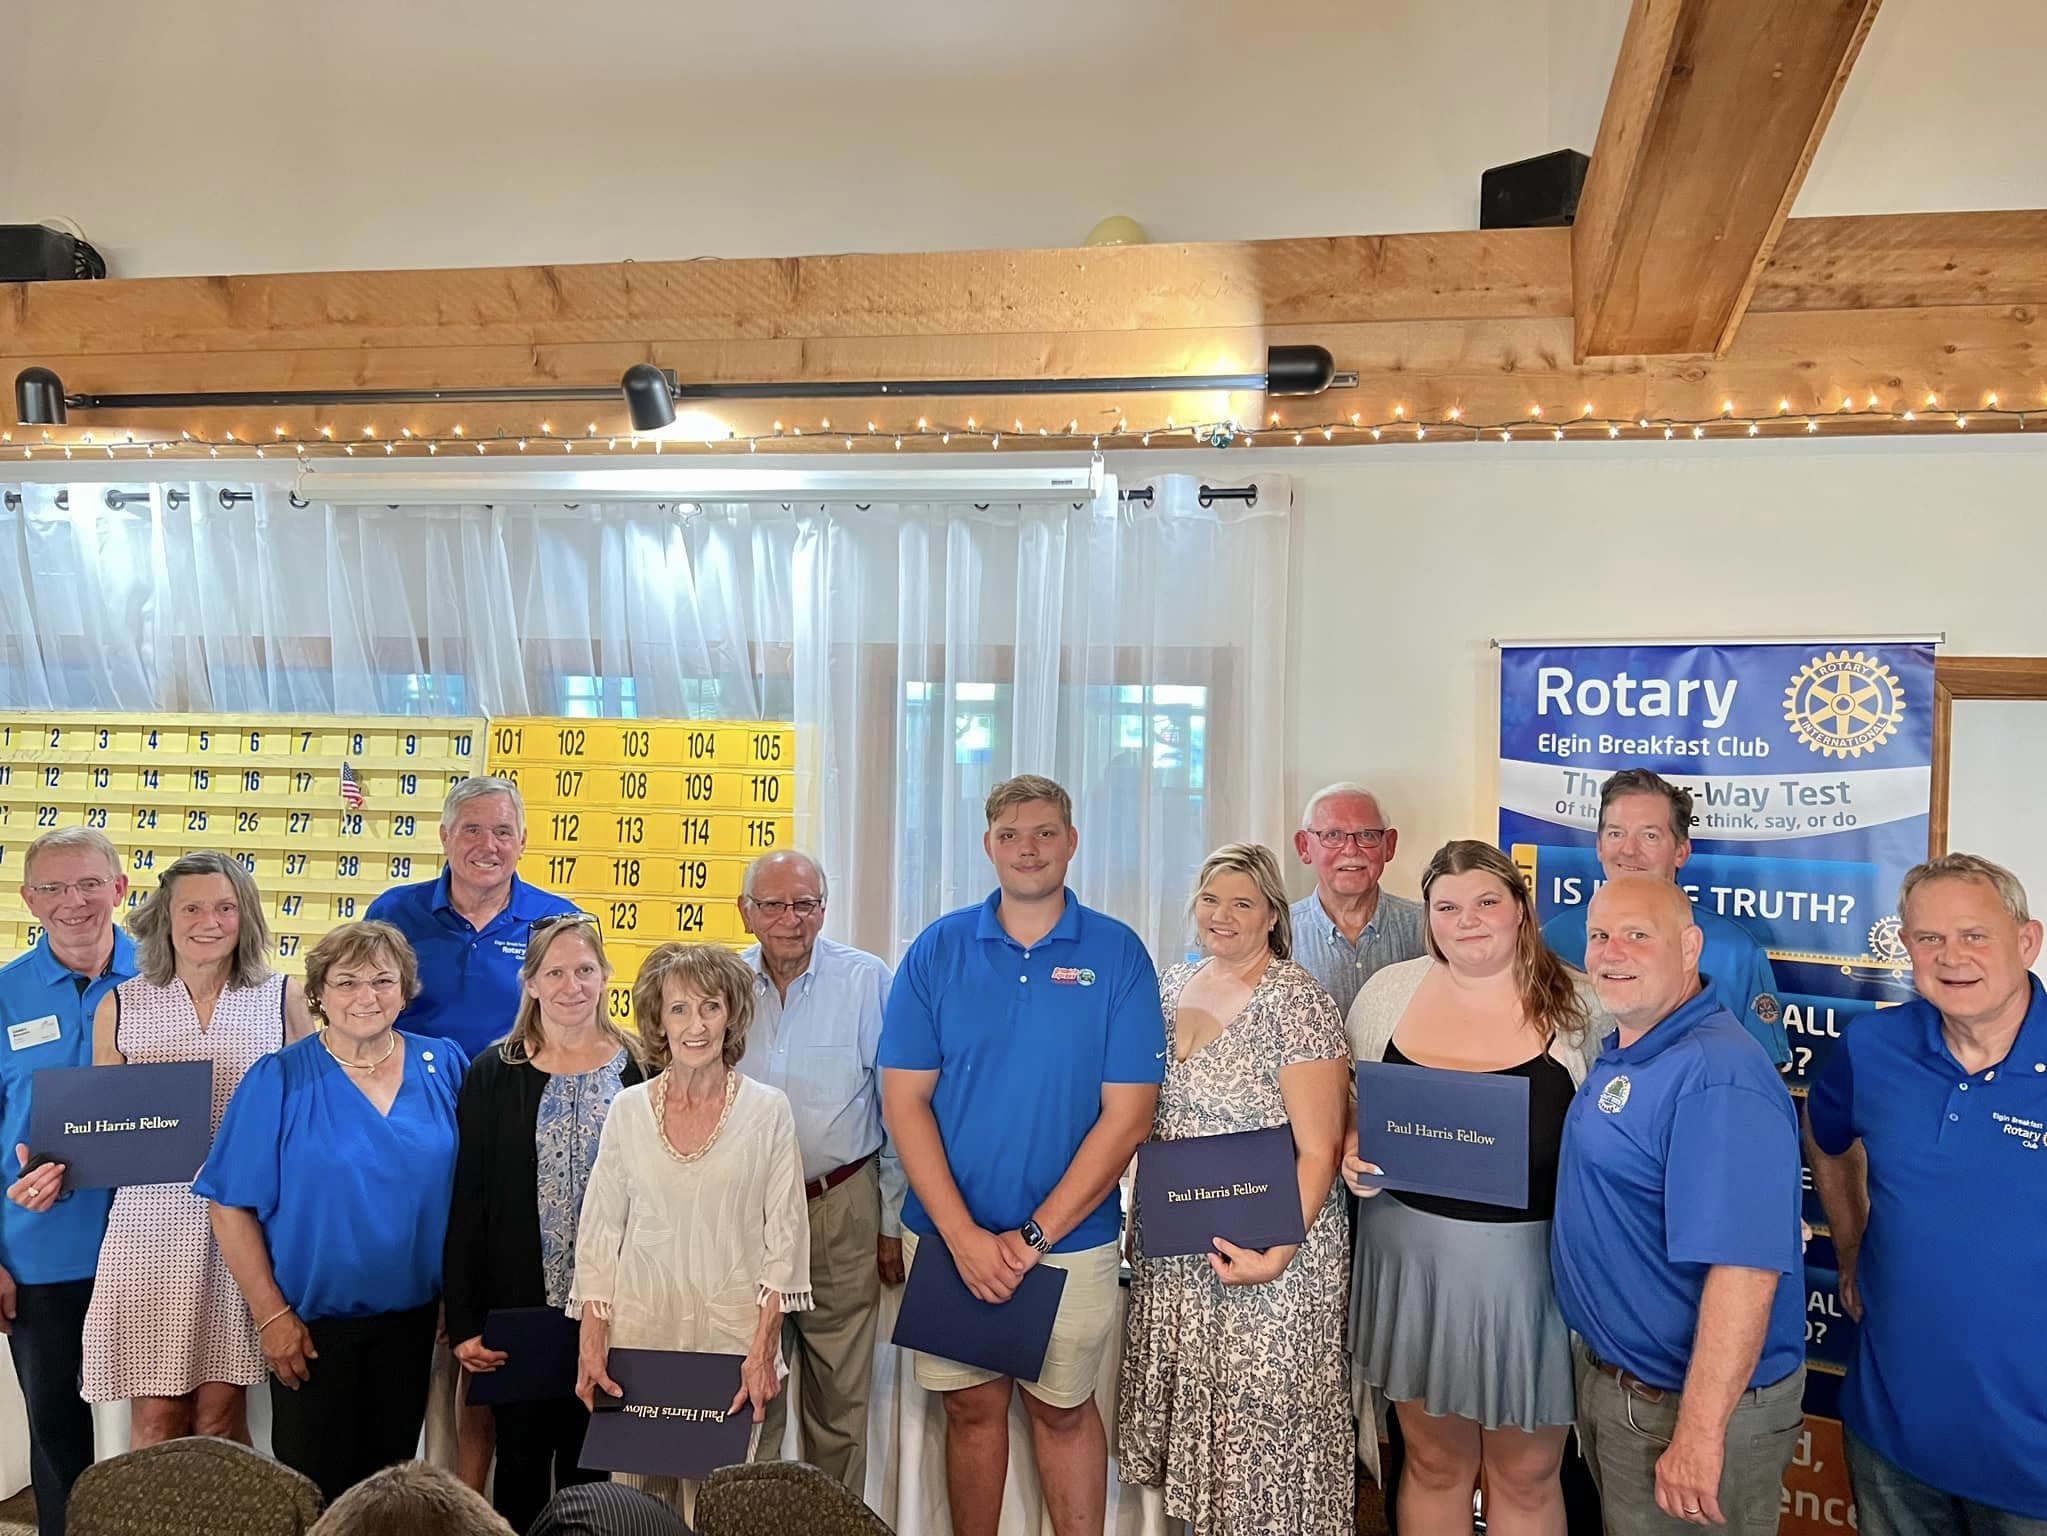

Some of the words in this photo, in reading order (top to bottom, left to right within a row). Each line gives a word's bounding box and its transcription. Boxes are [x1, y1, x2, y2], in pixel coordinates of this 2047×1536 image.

[1819, 661, 1870, 676] ROTARY
[1537, 667, 1738, 728] Rotary
[4, 727, 10, 746] 1
[50, 728, 60, 748] 2
[99, 729, 108, 749] 3
[148, 730, 157, 749] 4
[200, 731, 209, 751] 5
[250, 732, 259, 752] 6
[301, 731, 312, 752] 7
[353, 733, 363, 755] 8
[406, 734, 416, 755] 9
[454, 735, 472, 756] 10
[495, 728, 522, 754] 101
[558, 729, 585, 756] 102
[622, 731, 649, 757] 103
[688, 732, 715, 759] 104
[753, 734, 781, 760] 105
[1538, 733, 1592, 757] Elgin
[1599, 735, 1711, 756] Breakfast
[1717, 736, 1770, 757] Club
[1801, 720, 1887, 748] INTERNATIONAL
[45, 767, 60, 787] 12
[94, 768, 109, 788] 13
[143, 769, 158, 789] 14
[194, 769, 209, 789] 15
[244, 771, 260, 791] 16
[296, 772, 312, 792] 17
[400, 774, 417, 795] 19
[556, 771, 583, 797] 107
[620, 772, 647, 799] 108
[685, 774, 713, 801] 109
[752, 776, 779, 802] 110
[1563, 771, 1600, 798] Th
[1779, 781, 1852, 806] Test
[38, 806, 57, 827] 22
[88, 808, 107, 828] 23
[137, 809, 156, 829] 24
[188, 810, 207, 831] 25
[239, 811, 259, 832] 26
[290, 812, 310, 833] 27
[342, 814, 362, 835] 28
[394, 815, 415, 836] 29
[1555, 800, 1575, 815] Of
[1580, 803, 1600, 818] th
[1705, 813, 1759, 830] think,
[1765, 816, 1801, 832] say,
[1807, 815, 1827, 828] or
[1832, 811, 1857, 827] do
[552, 814, 579, 841] 112
[617, 816, 643, 843] 113
[682, 818, 709, 845] 114
[748, 820, 775, 847] 115
[134, 849, 153, 869] 34
[286, 854, 306, 874] 37
[338, 855, 359, 877] 38
[391, 857, 411, 878] 39
[549, 856, 576, 884] 117
[613, 859, 640, 886] 118
[679, 861, 707, 888] 119
[282, 896, 302, 916] 47
[1554, 876, 1582, 905] IS
[1710, 886, 1856, 924] TRUTH?
[610, 902, 637, 930] 123
[676, 903, 703, 932] 124
[279, 935, 299, 957] 57
[609, 989, 630, 1017] 33
[1783, 1004, 1841, 1038] ALL
[64, 1121, 92, 1135] Paul
[95, 1118, 136, 1133] Harris
[139, 1116, 180, 1130] Fellow
[1387, 1120, 1412, 1135] Paul
[1415, 1123, 1454, 1140] Harris
[1456, 1128, 1496, 1145] Fellow
[2003, 1124, 2041, 1142] Rotary
[1167, 1189, 1192, 1203] Paul
[1194, 1185, 1231, 1200] Harris
[1231, 1182, 1269, 1196] Fellow
[623, 1404, 660, 1418] Fellow
[661, 1407, 698, 1421] Harris
[700, 1409, 726, 1423] Paul
